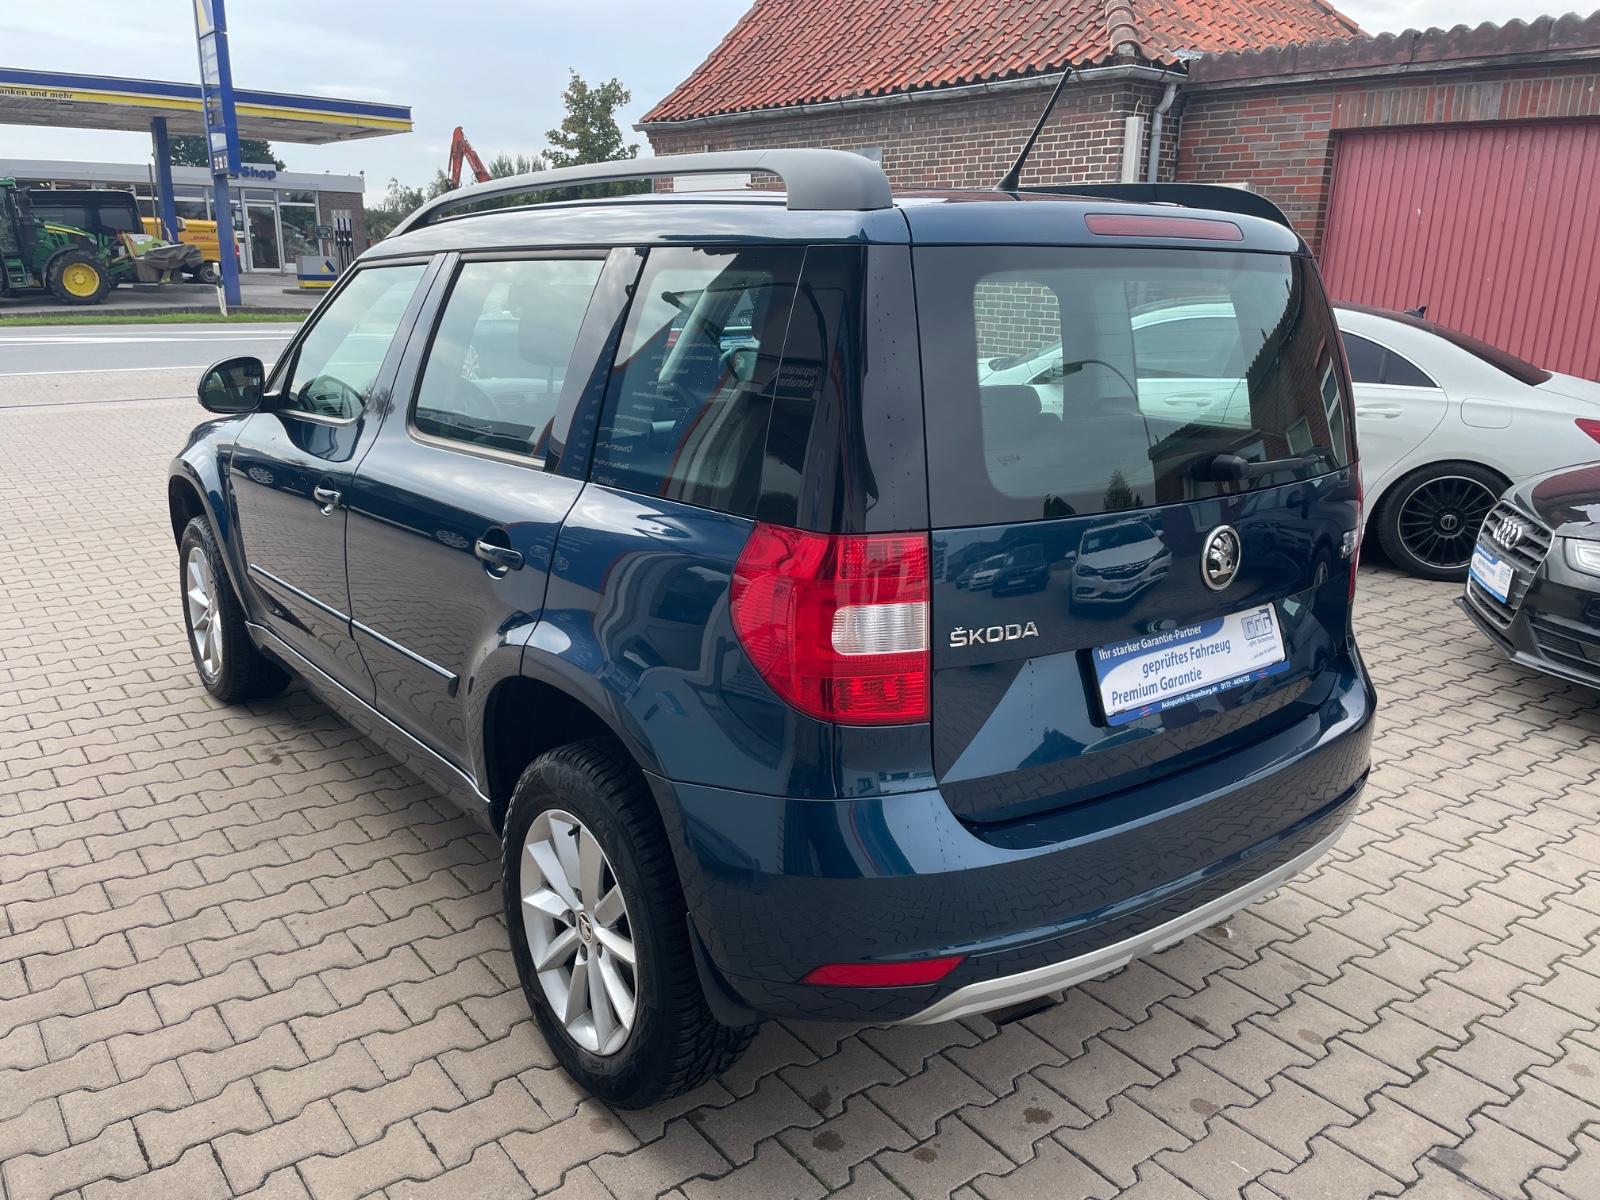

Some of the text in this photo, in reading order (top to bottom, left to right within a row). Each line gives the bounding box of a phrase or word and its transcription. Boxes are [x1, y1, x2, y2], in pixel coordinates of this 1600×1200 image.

[30, 90, 47, 98] und
[50, 91, 73, 100] mehr
[241, 165, 277, 180] Shop
[949, 621, 1039, 648] ŠKODA
[1098, 625, 1203, 660] Ihr starker Garantie-Partner
[1142, 651, 1189, 678] geprüftes
[1189, 639, 1231, 660] Fahrzeug
[1111, 667, 1203, 706] Premium Garantie
